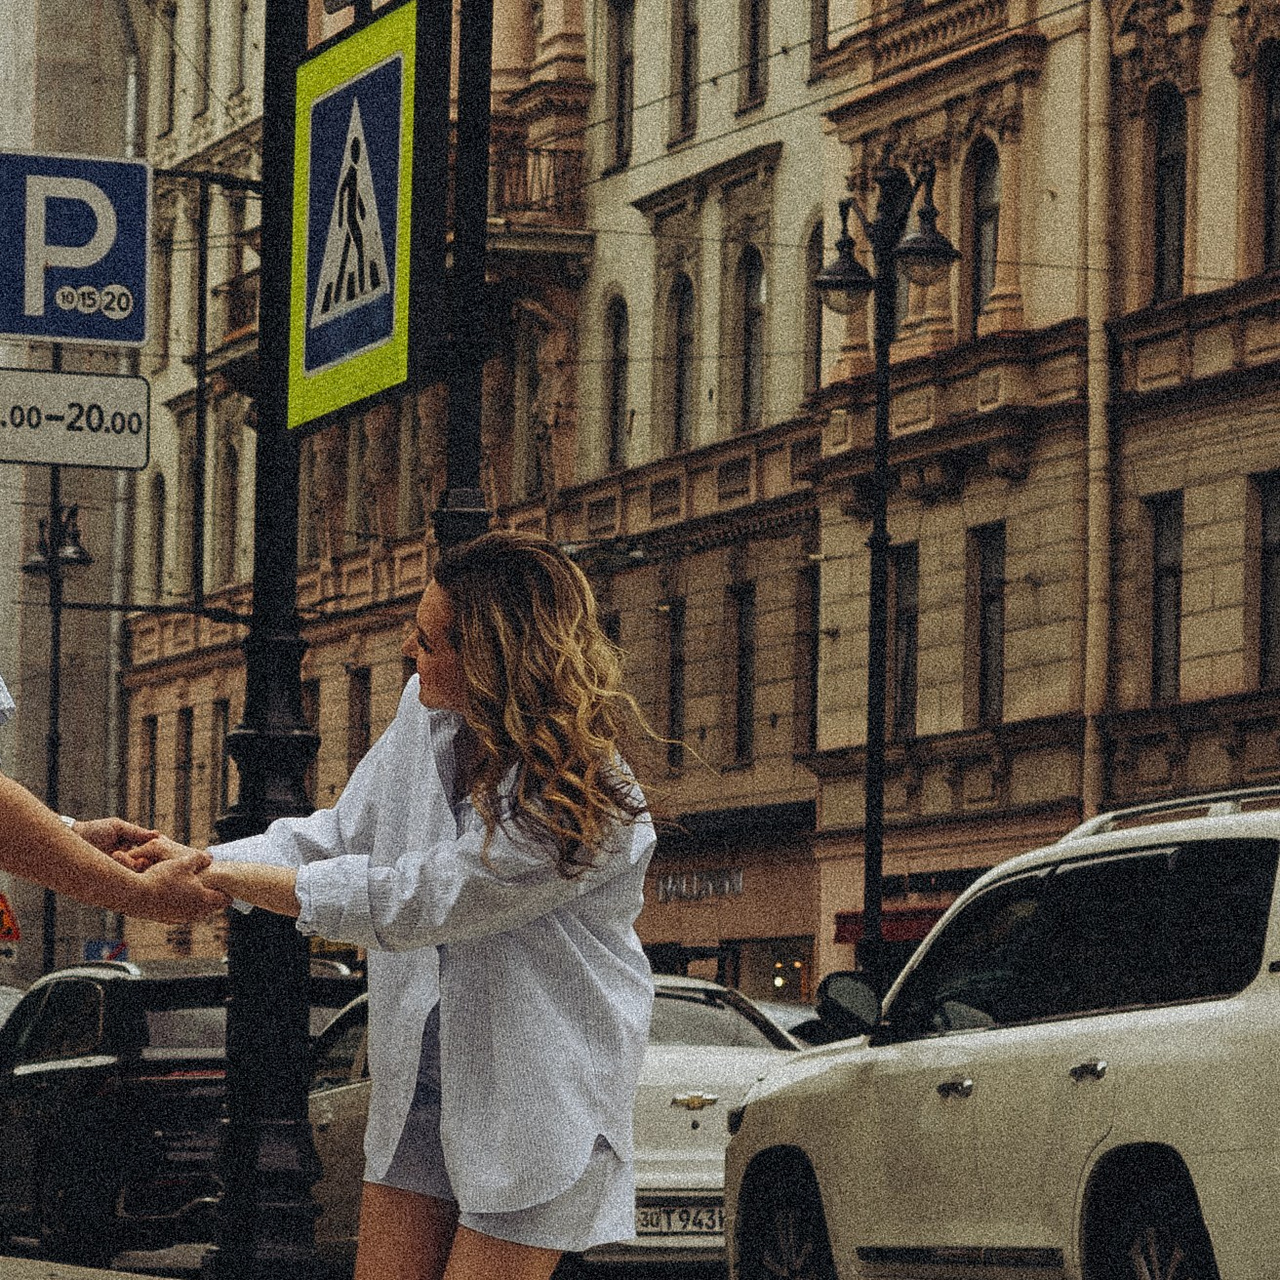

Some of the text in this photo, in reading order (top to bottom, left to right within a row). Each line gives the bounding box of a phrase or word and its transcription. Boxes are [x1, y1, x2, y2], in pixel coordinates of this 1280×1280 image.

[24, 174, 118, 317] P
[81, 291, 97, 309] 15
[103, 291, 131, 313] 20
